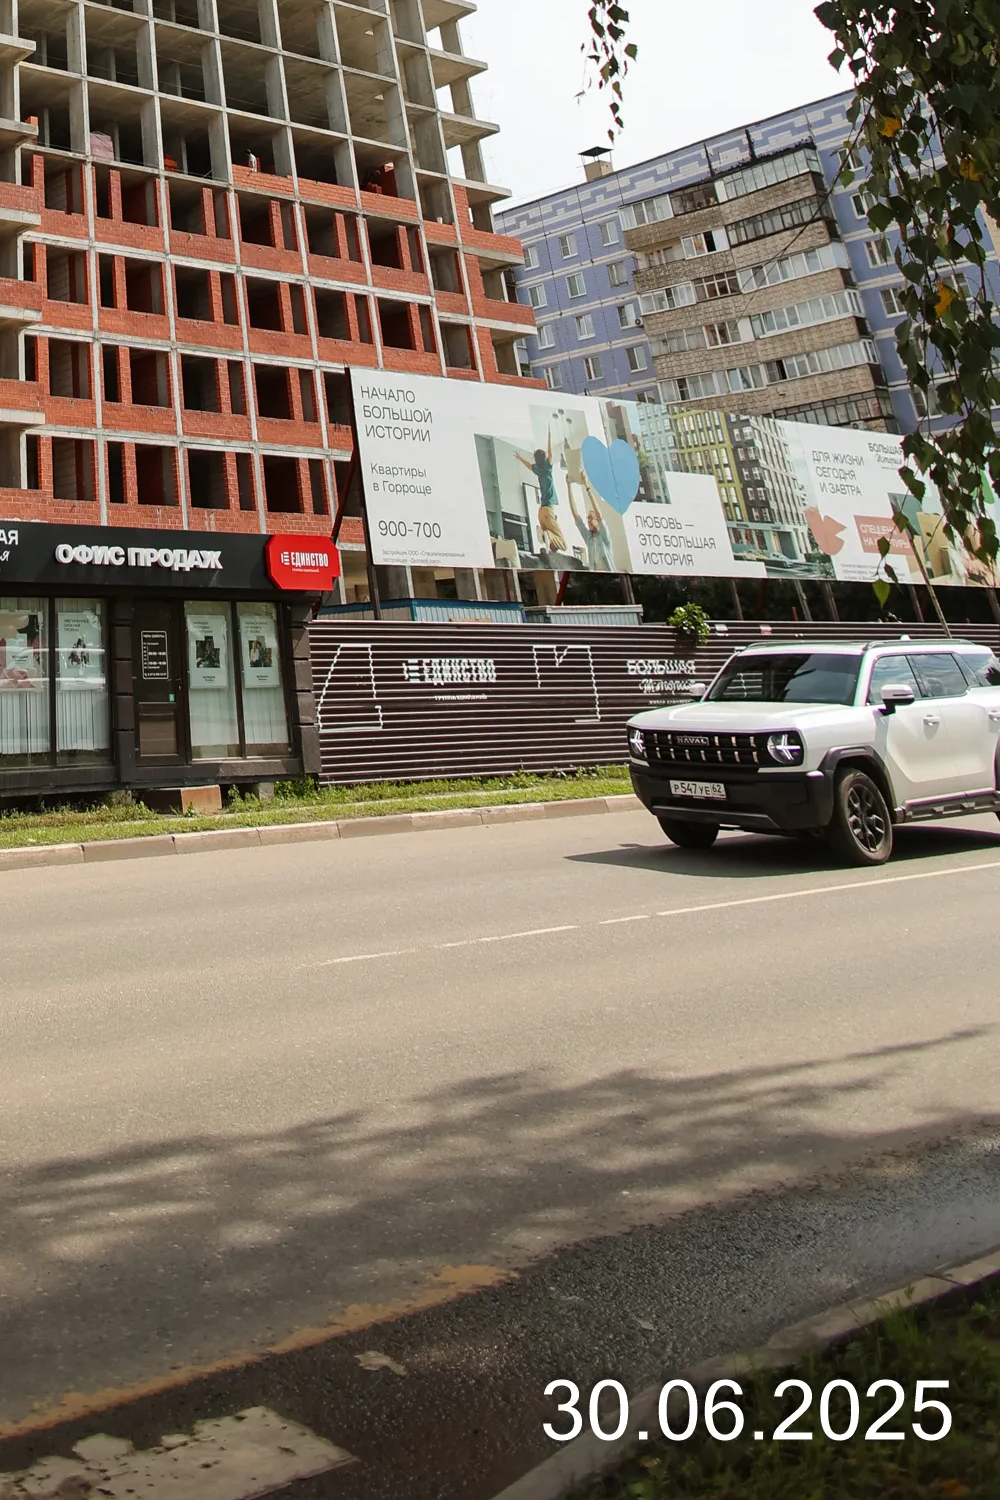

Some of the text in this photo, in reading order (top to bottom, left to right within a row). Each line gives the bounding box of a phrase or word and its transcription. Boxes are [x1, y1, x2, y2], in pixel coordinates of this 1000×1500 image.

[360, 386, 416, 404] НАЧАЛО
[363, 405, 433, 424] БОЛЬШОЙ
[365, 424, 431, 443] ИСТОРИИ
[811, 450, 865, 466] ДЛЯ ЖИЗНИ
[875, 453, 902, 466] Истори
[370, 462, 427, 478] Квартиры
[815, 466, 857, 482] СЕГОДНЯ
[373, 480, 432, 495] в Горроще
[820, 482, 863, 497] И ЗАВТРА
[378, 520, 442, 539] 900-700
[635, 515, 683, 530] ЛЮБОВЬ
[638, 533, 717, 550] ЭТО БОЛЬШАЯ
[55, 543, 224, 572] ОФИС ПРОДАЖ
[290, 551, 329, 568] ЕДИНСТВО
[642, 552, 695, 567] ИСТОРИЯ
[422, 659, 497, 686] ЕДИНСТВО
[626, 660, 697, 675] БОЛЬШАЯ
[712, 783, 723, 793] 62
